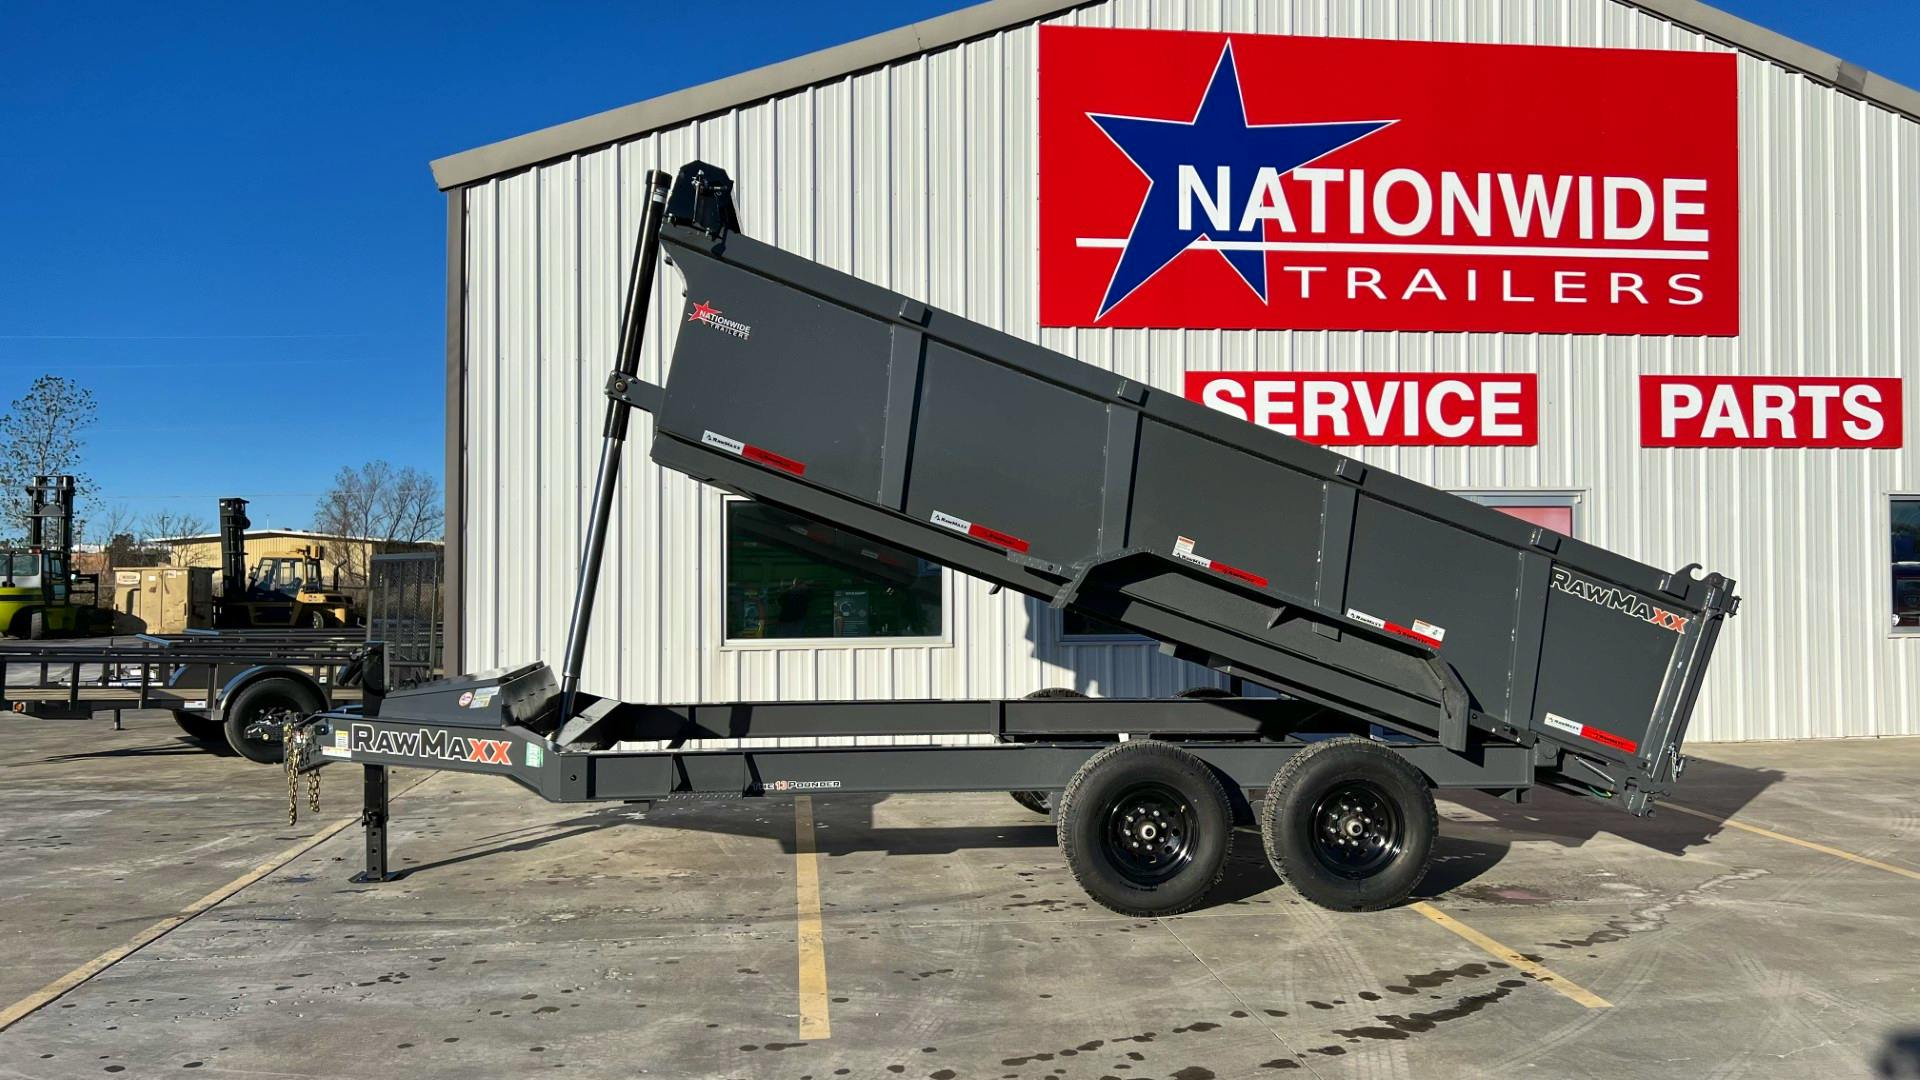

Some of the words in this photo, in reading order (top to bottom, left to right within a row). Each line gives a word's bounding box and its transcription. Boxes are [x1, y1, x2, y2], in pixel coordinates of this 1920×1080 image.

[1177, 164, 1709, 243] NATIONWIDE
[1282, 265, 1704, 306] TRAILERS
[699, 310, 751, 333] NATIONWIDE
[710, 322, 749, 341] TRAILERS
[1202, 378, 1523, 438] SERVICE
[1660, 384, 1885, 440] PARTS
[351, 723, 513, 766] RAWMAXX
